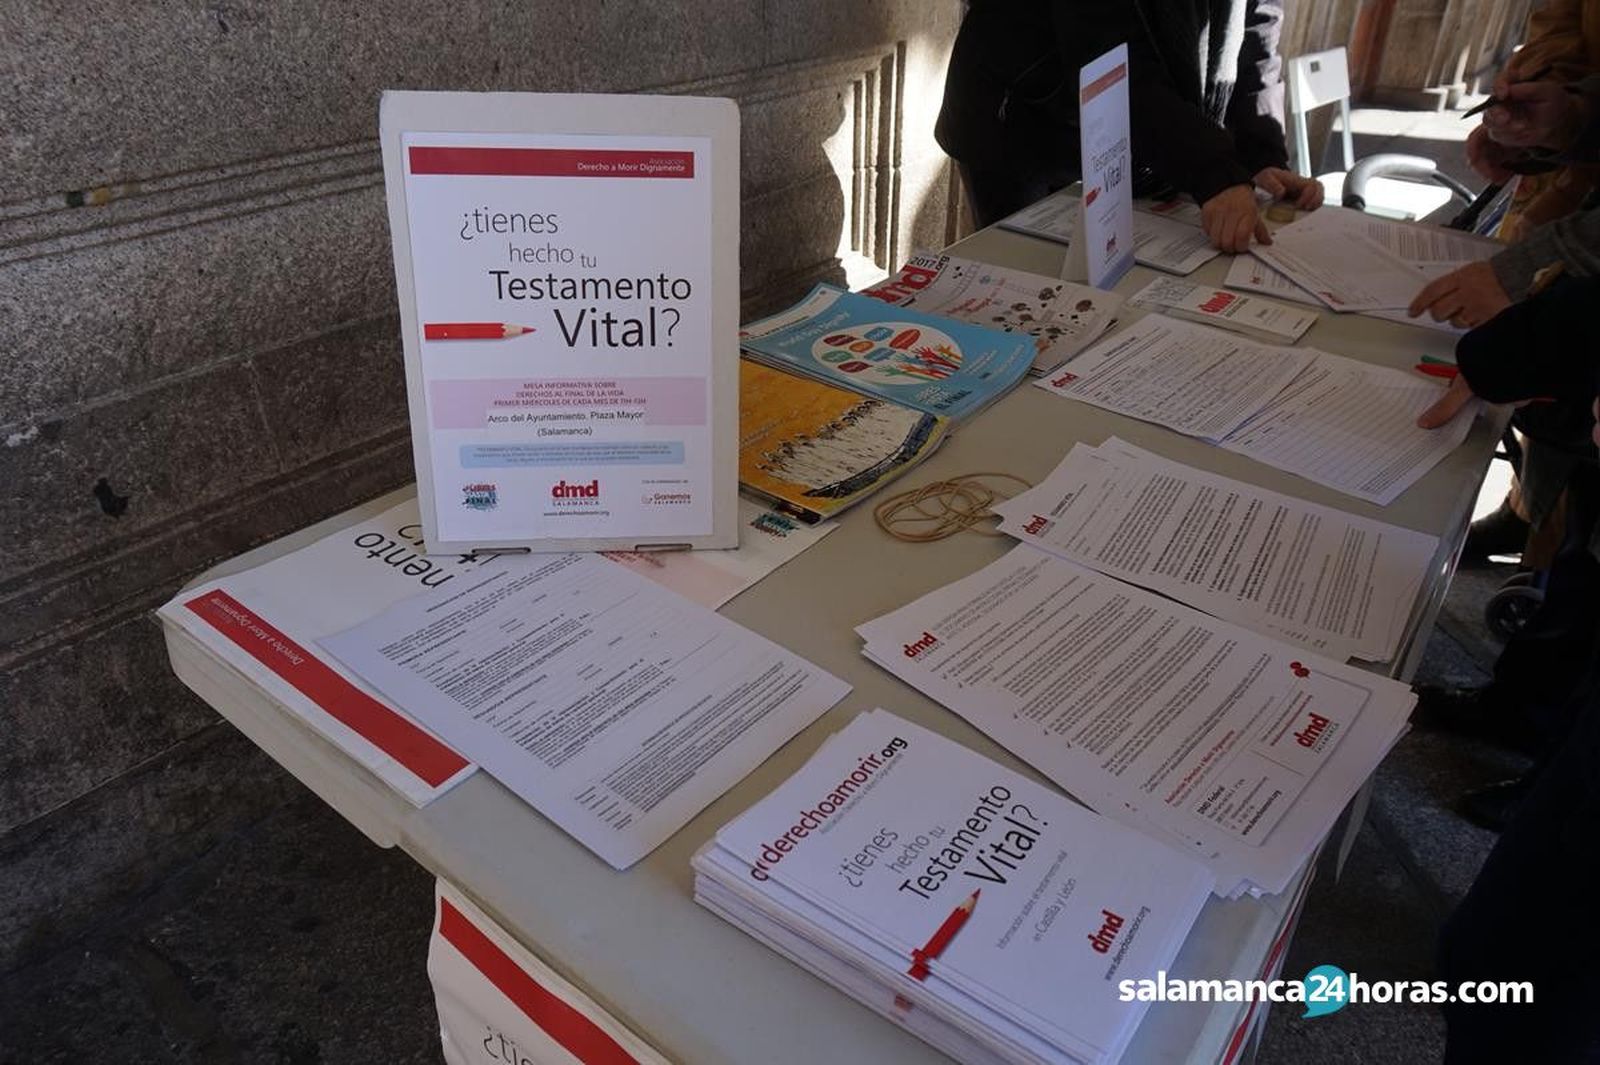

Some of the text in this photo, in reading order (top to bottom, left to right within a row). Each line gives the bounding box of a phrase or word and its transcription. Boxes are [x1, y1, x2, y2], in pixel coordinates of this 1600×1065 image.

[577, 162, 609, 171] Derecho
[618, 163, 638, 171] Morir
[640, 163, 685, 173] Dignamente
[460, 206, 558, 240] ¿tienes
[509, 242, 598, 268] hecho tu
[910, 256, 936, 268] 2017
[489, 270, 692, 301] Testamento
[553, 306, 682, 348] Vital?
[515, 391, 553, 399] DERECHOS
[487, 415, 509, 423] Arco
[510, 414, 525, 422] del
[590, 411, 615, 420] Plaza
[616, 410, 644, 422] Mayor
[536, 426, 593, 437] (Salamanca)
[552, 480, 599, 498] dmd
[1022, 514, 1048, 535] dmd
[903, 631, 938, 658] dmd
[1293, 712, 1331, 748] dmd
[760, 736, 908, 864] derechoamorir.org
[838, 827, 899, 888] ¿tienes
[886, 826, 946, 874] hecho tu
[899, 785, 1011, 900] Testamento
[963, 804, 1049, 885] Vital?
[1034, 904, 1061, 934] Castilla
[1062, 877, 1077, 900] León
[1088, 909, 1125, 954] dmd
